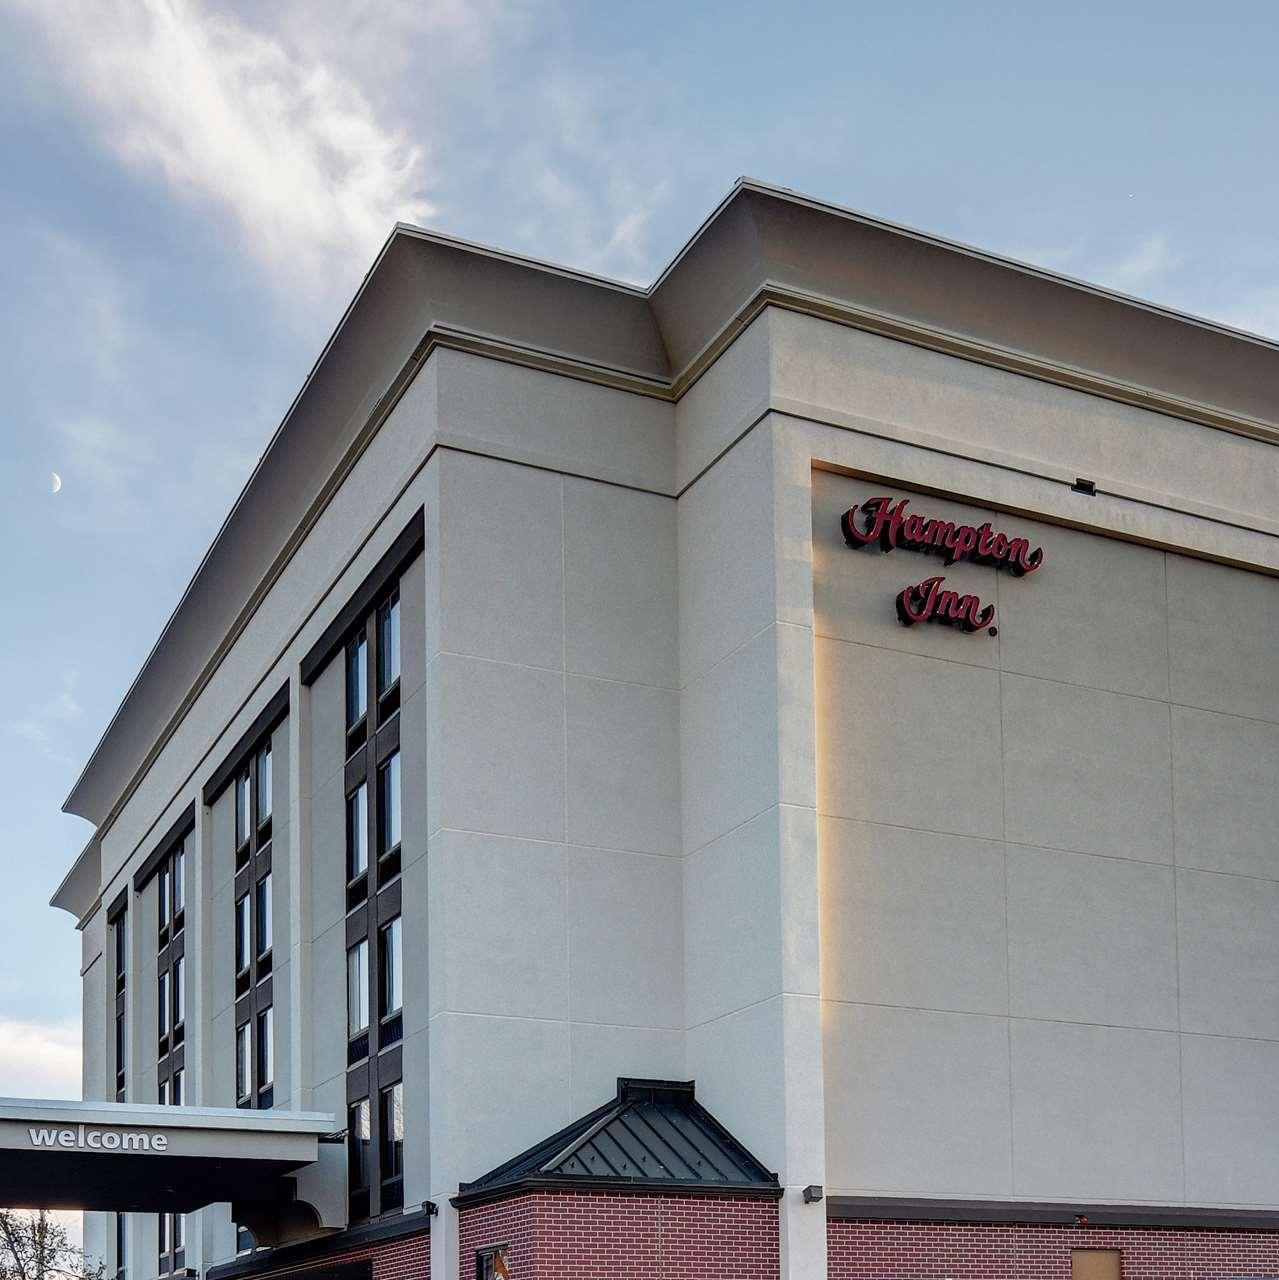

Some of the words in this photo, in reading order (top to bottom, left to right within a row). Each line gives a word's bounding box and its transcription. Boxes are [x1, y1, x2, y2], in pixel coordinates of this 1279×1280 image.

[841, 497, 1044, 577] Hampton
[896, 576, 995, 632] Inn
[29, 1124, 168, 1151] welcome
